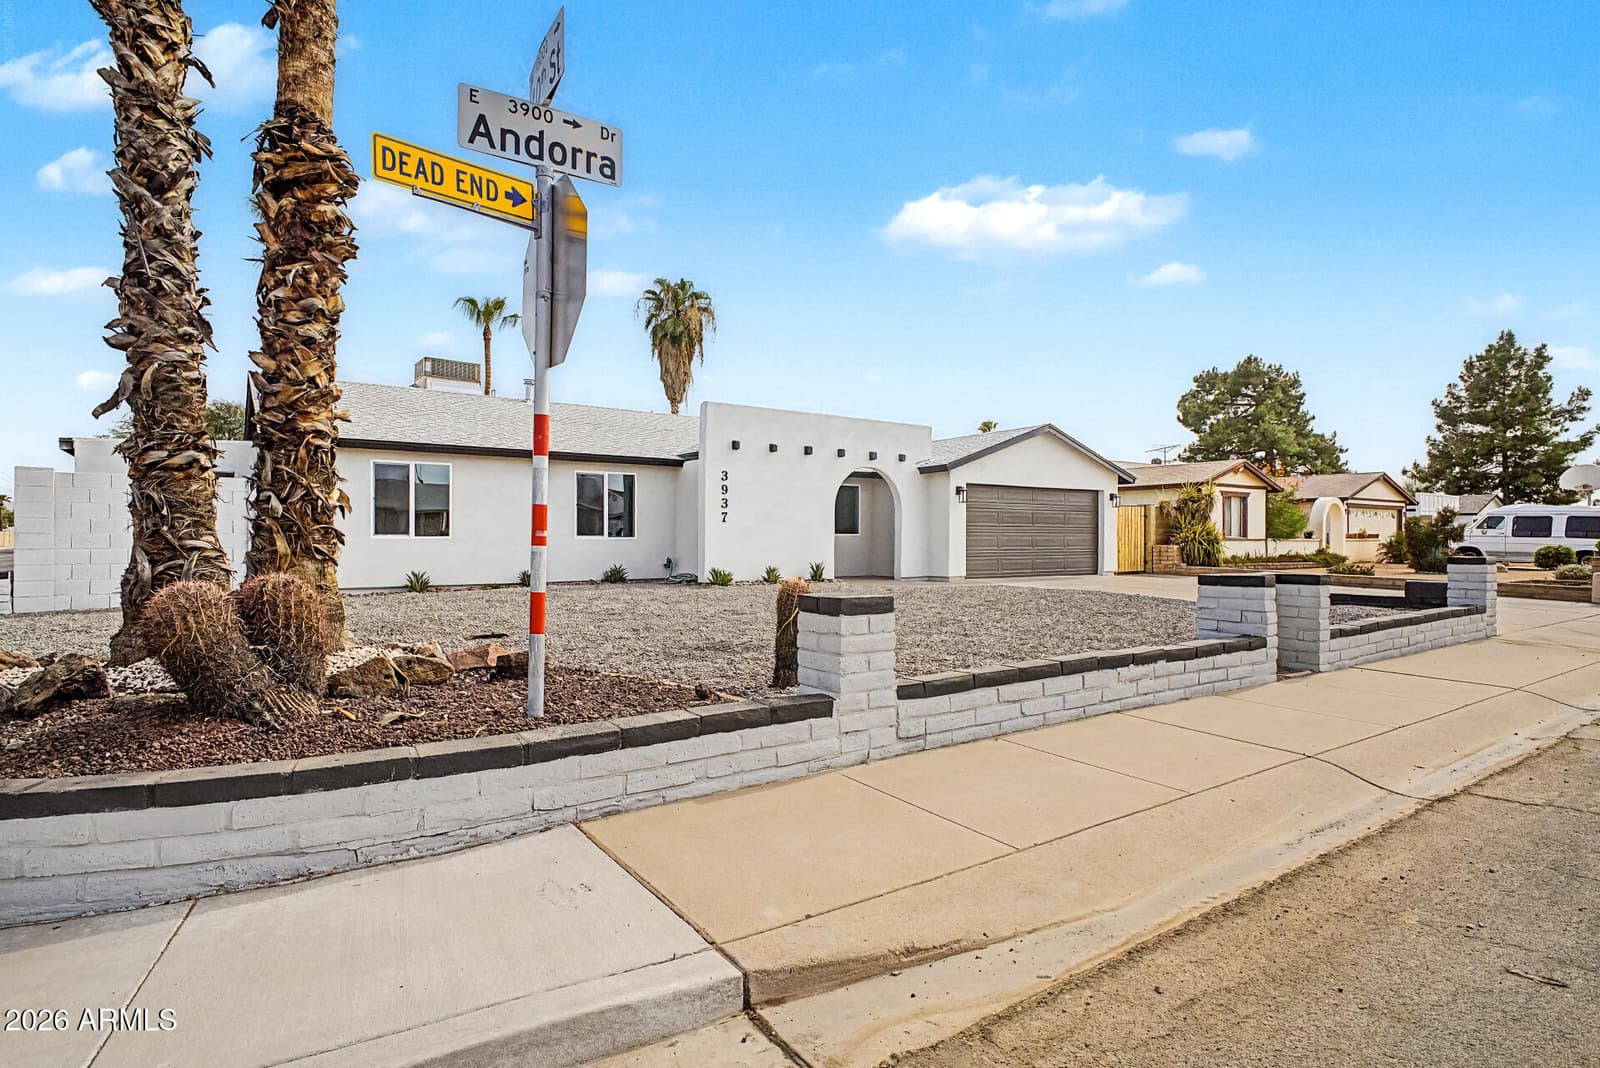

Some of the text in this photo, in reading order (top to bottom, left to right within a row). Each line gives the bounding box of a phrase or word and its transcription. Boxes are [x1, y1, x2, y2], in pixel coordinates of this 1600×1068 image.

[549, 39, 561, 84] St
[469, 88, 617, 143] E 3900 Dr
[381, 145, 499, 202] DEAD END
[467, 113, 616, 181] Andorra
[720, 470, 728, 522] 3937
